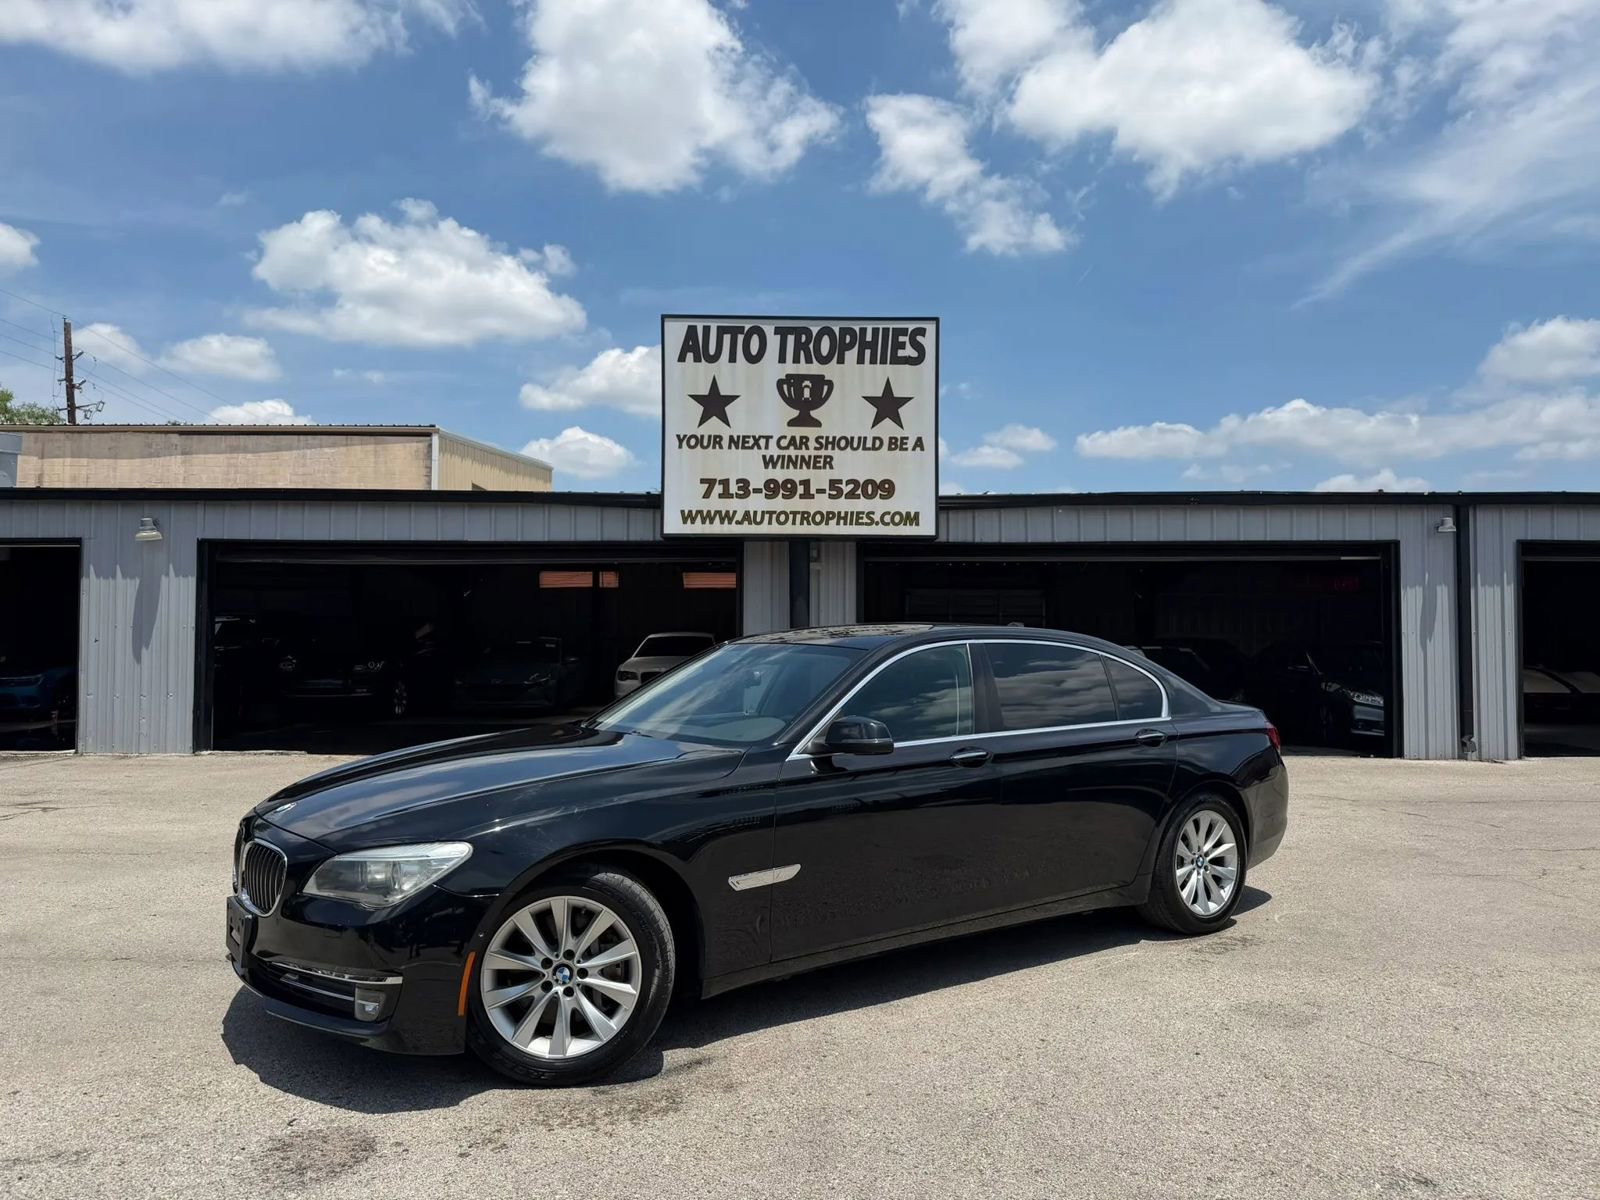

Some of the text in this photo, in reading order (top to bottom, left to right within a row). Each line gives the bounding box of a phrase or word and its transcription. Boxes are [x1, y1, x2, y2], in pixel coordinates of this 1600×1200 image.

[677, 324, 927, 366] AUTO TROPHIES
[676, 434, 925, 451] YOUR NEXT CAR SHOULD BE A
[762, 454, 834, 470] WINNER
[700, 478, 896, 500] 713-991-5209
[680, 509, 920, 527] WWW.AUTOTROPHIES.COM
